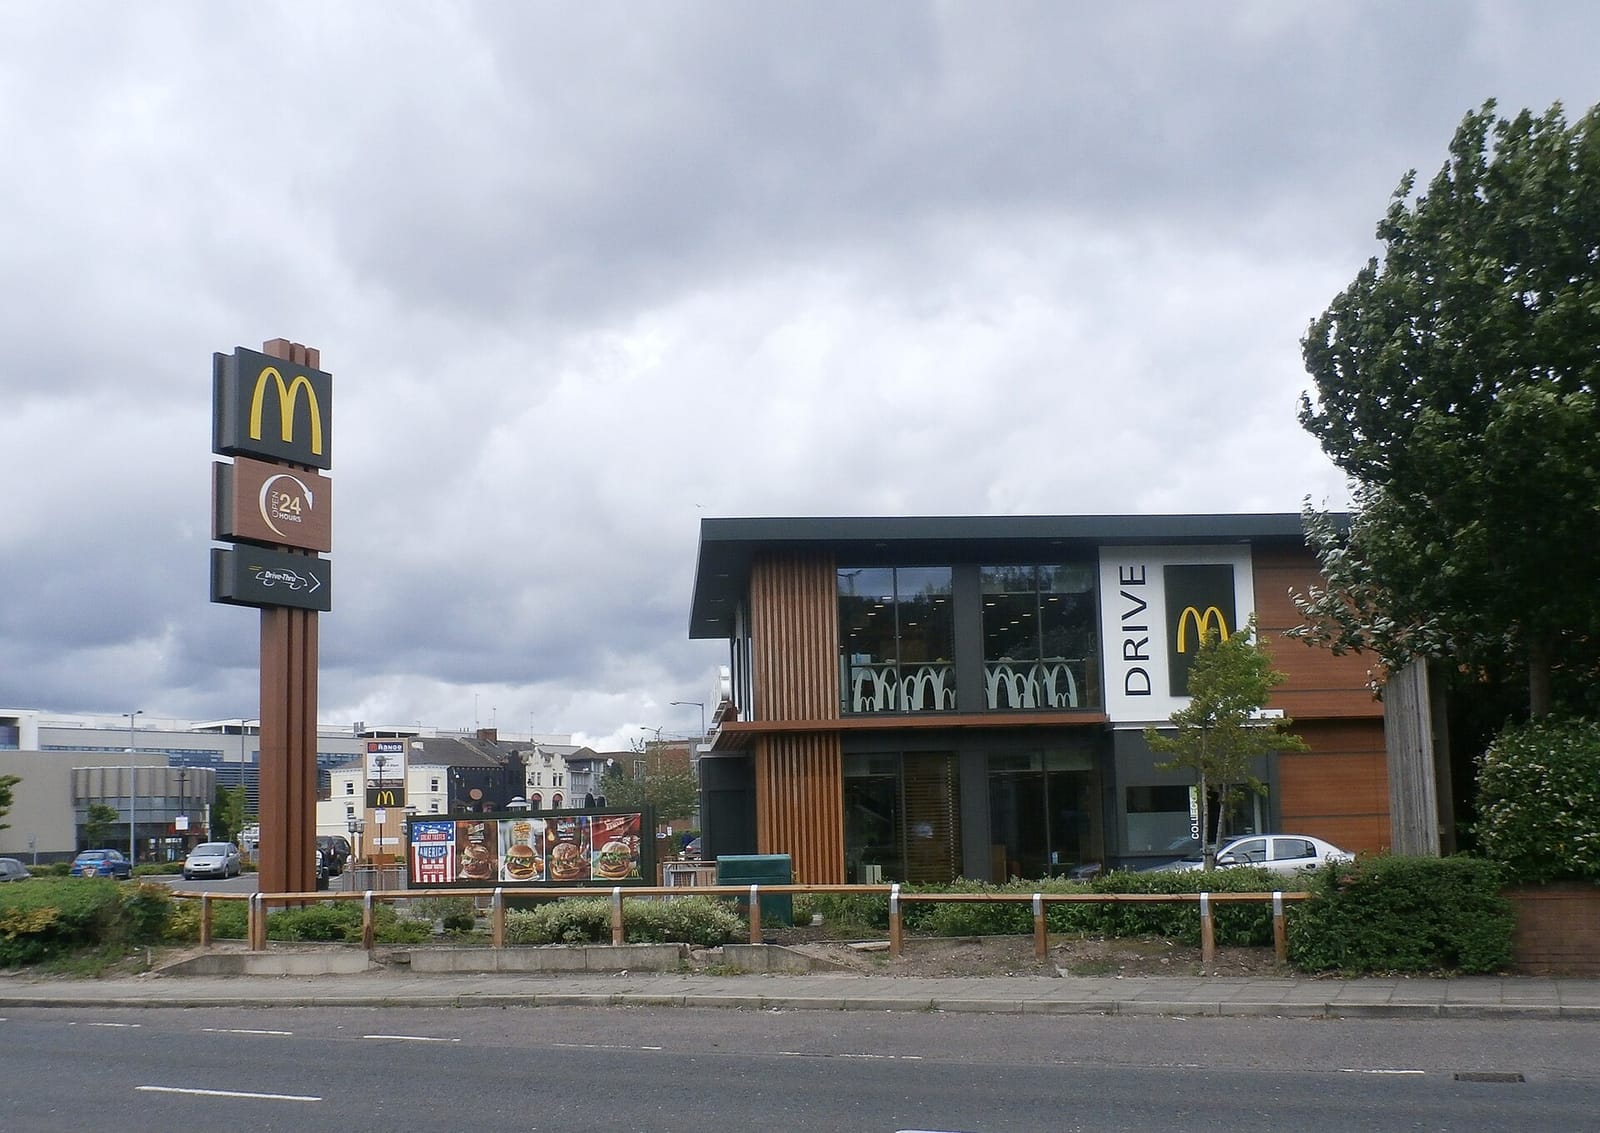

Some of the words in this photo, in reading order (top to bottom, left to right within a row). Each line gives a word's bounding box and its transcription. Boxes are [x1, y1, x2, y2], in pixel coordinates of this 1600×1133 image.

[271, 490, 279, 518] OPEN
[280, 493, 301, 515] 24
[279, 512, 301, 522] HOURS
[265, 571, 296, 583] Drive-Thru
[1119, 565, 1151, 696] DRIVE
[418, 847, 447, 857] AMERICA
